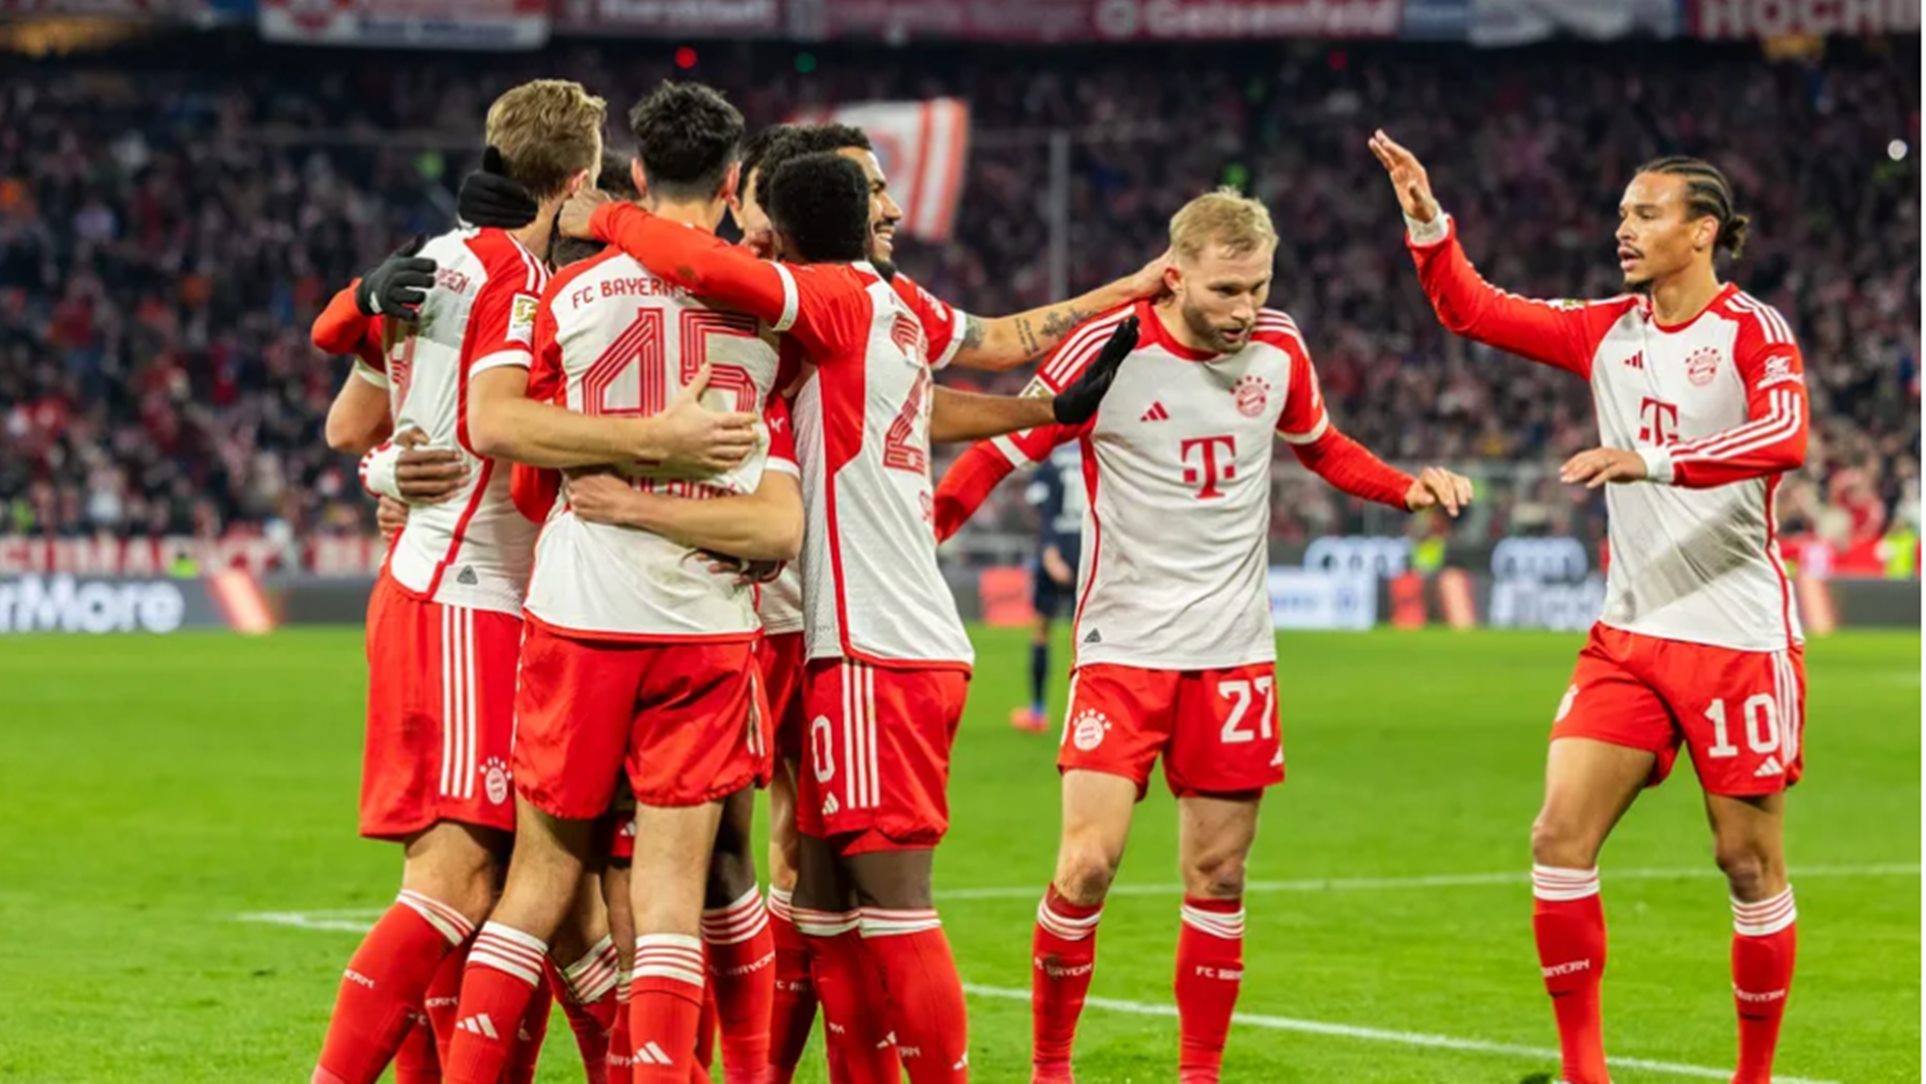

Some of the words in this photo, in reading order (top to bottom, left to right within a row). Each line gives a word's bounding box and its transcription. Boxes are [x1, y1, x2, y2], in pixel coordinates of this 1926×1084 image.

[571, 286, 594, 309] FC
[581, 307, 759, 418] 45
[1181, 435, 1236, 499] T
[1217, 676, 1275, 744] 27
[1704, 692, 1781, 759] 10
